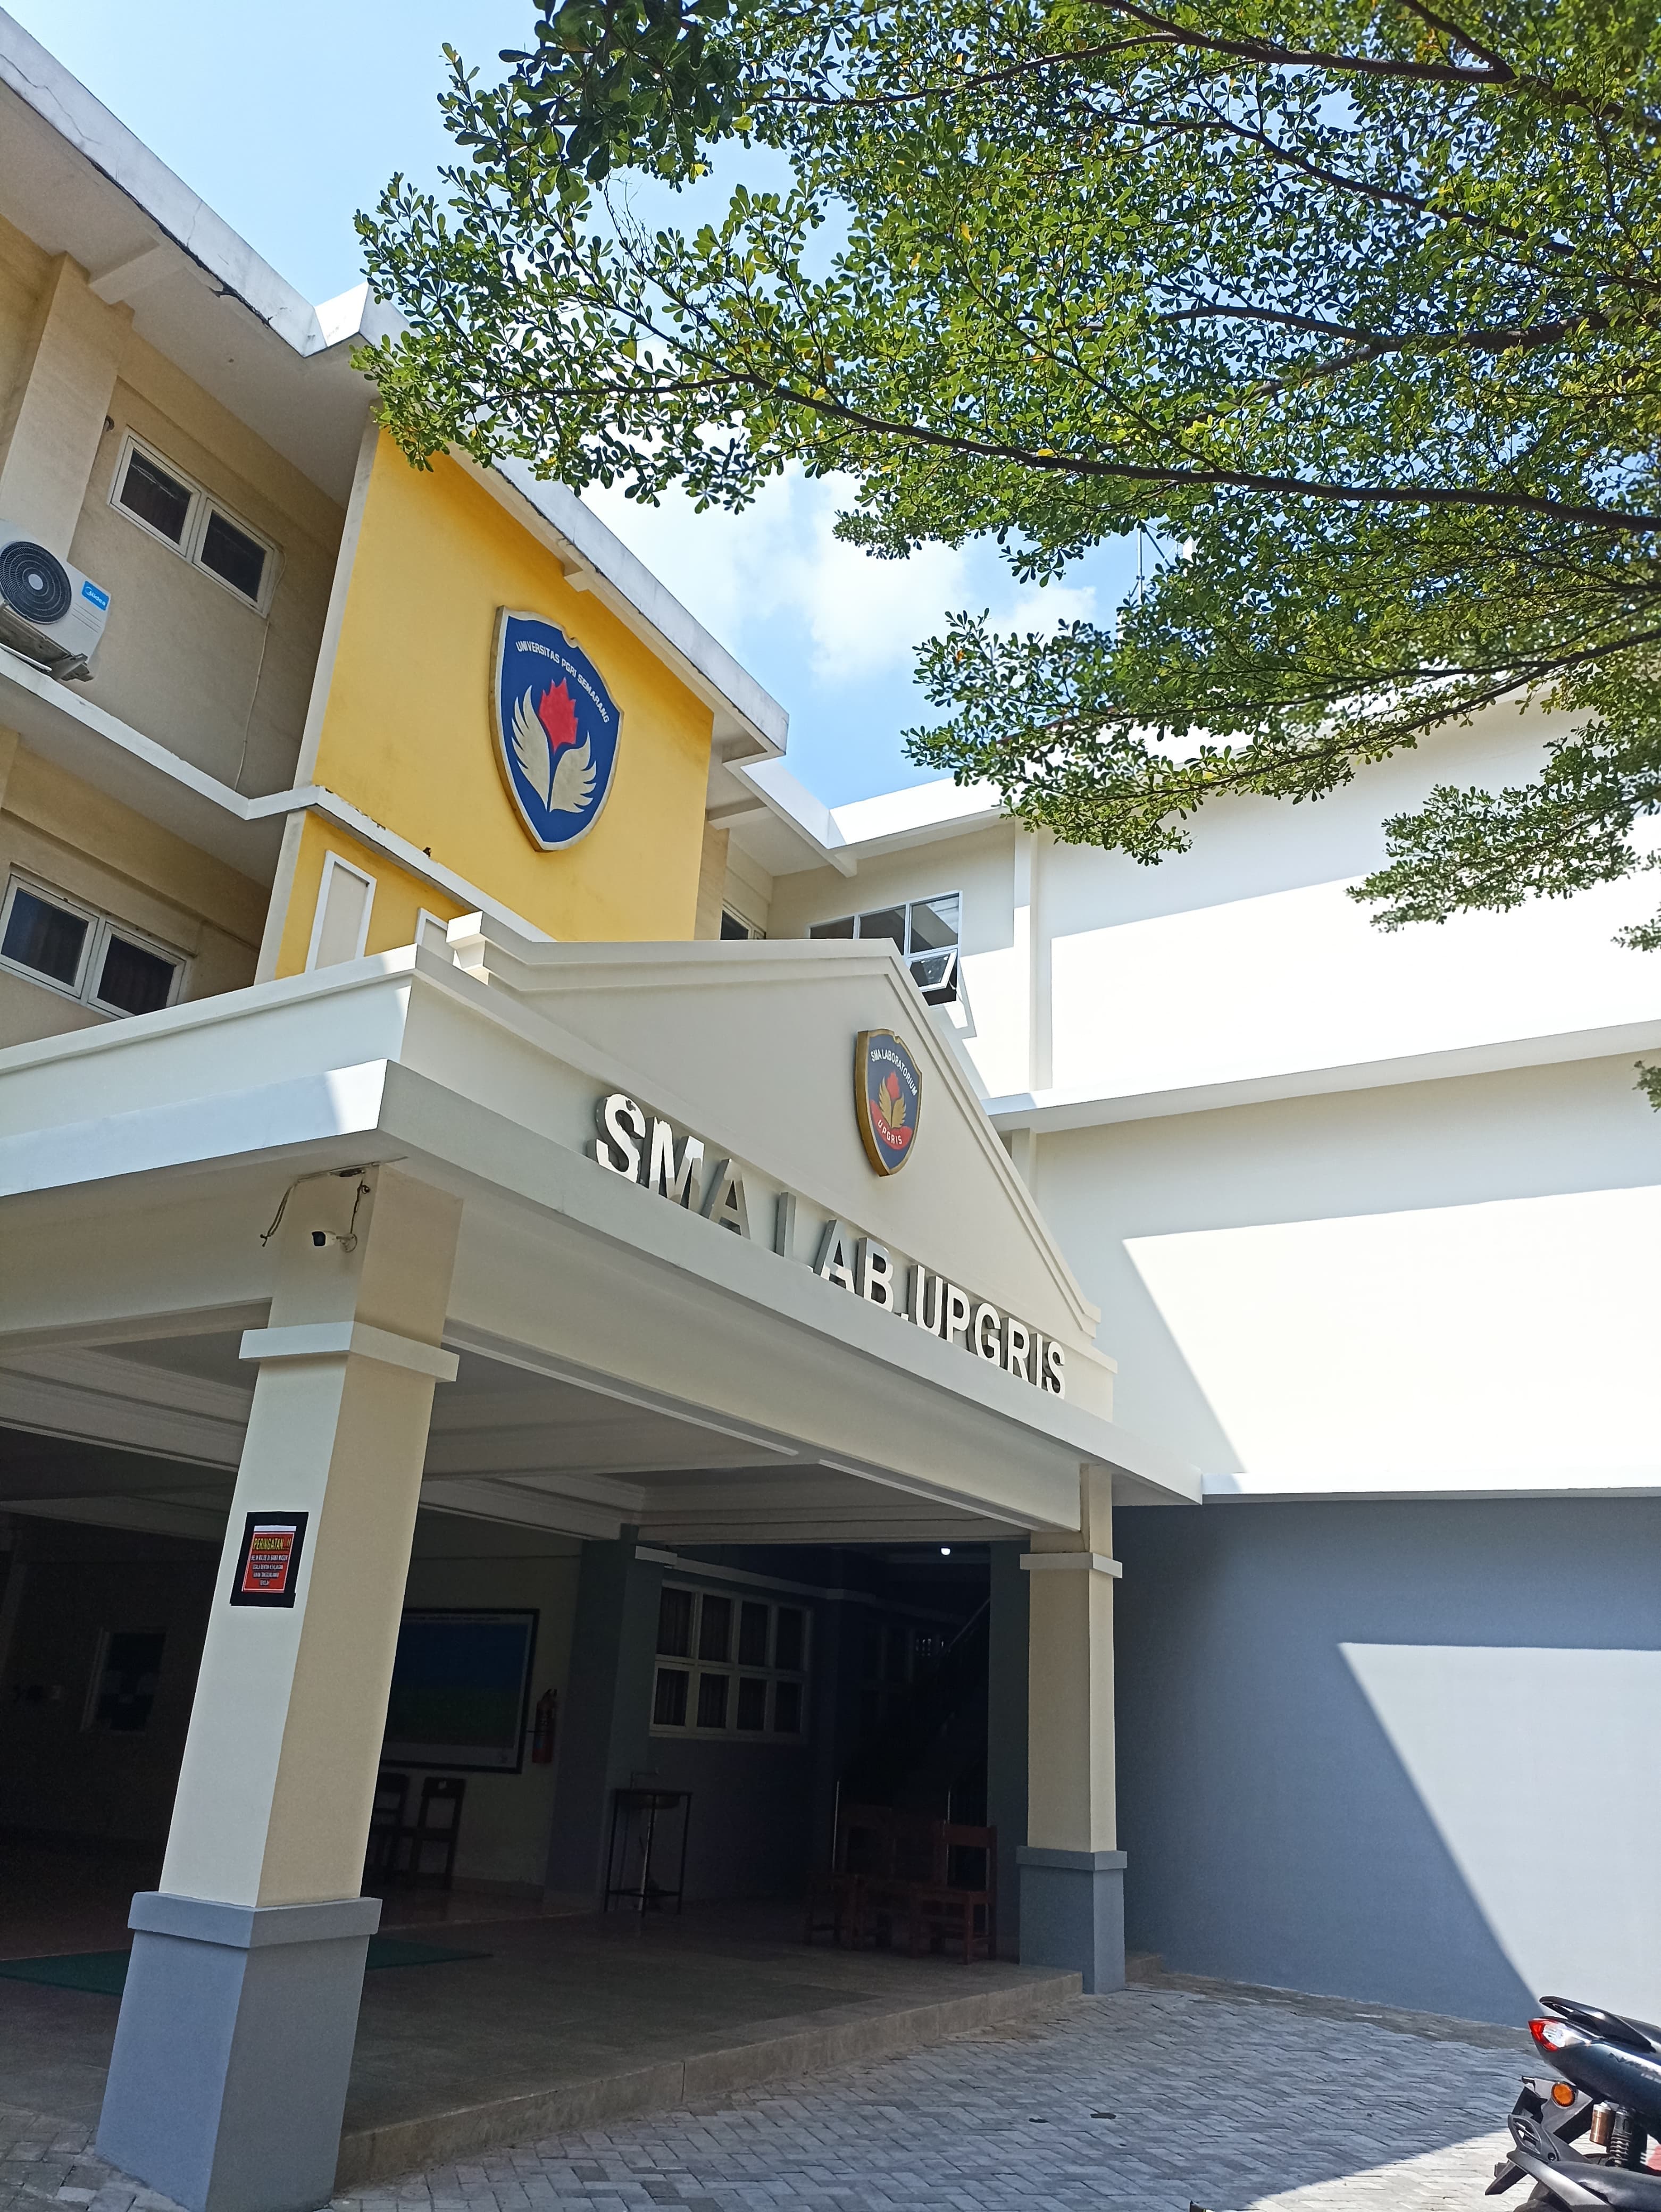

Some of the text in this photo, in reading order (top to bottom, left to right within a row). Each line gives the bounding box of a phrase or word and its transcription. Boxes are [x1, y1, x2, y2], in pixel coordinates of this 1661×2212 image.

[515, 641, 610, 723] UNIVERSITAS PGRI SEMARANG
[870, 1049, 918, 1096] SMA LABORATORIUM
[878, 1119, 903, 1145] UPGRIS
[591, 1093, 751, 1240] SMA
